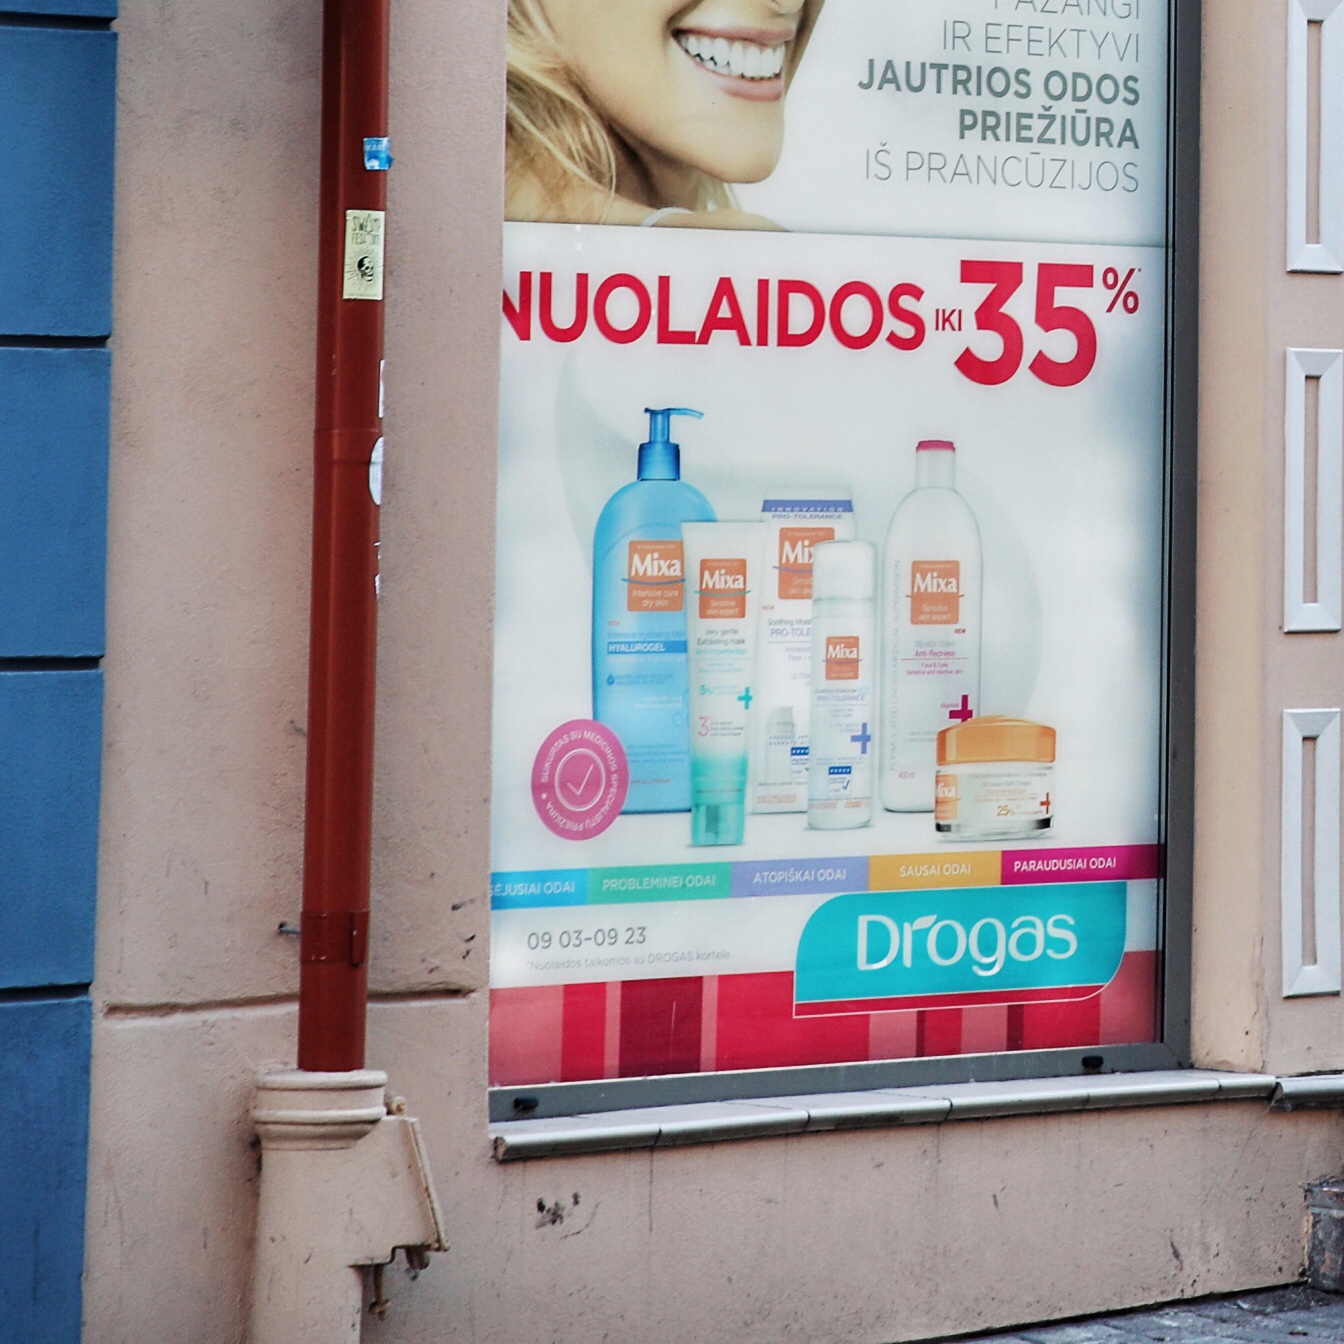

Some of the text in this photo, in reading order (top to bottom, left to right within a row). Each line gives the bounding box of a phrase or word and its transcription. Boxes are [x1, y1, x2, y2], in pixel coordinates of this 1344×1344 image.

[943, 19, 1140, 63] IR EFEKTYVI
[857, 58, 1141, 106] JAUTRIOS ODOS
[958, 105, 1140, 150] PRIEŽIŪRA
[865, 141, 1140, 193] IŠ PRANCŪZIJOS
[502, 270, 927, 352] NUOLAIDOS
[934, 308, 963, 333] IKI
[630, 552, 682, 577] Mixa
[702, 568, 745, 590] Mixa
[913, 570, 958, 594] Mixa
[608, 642, 666, 653] HYALUROGEL
[827, 644, 857, 659] Mixa
[543, 881, 575, 895] ODAI
[602, 876, 684, 891] PROBLEMINEI
[685, 875, 716, 887] ODAI
[752, 867, 816, 884] ATOPIŠKAI
[817, 868, 847, 882] ODAI
[899, 864, 941, 878] SAUSAI
[943, 863, 971, 875] ODAI
[1013, 858, 1087, 872] PARAUDUSIAI
[1089, 857, 1117, 869] ODAI
[527, 932, 552, 950] 09
[624, 927, 647, 945] 23
[857, 913, 1078, 978] Drogas
